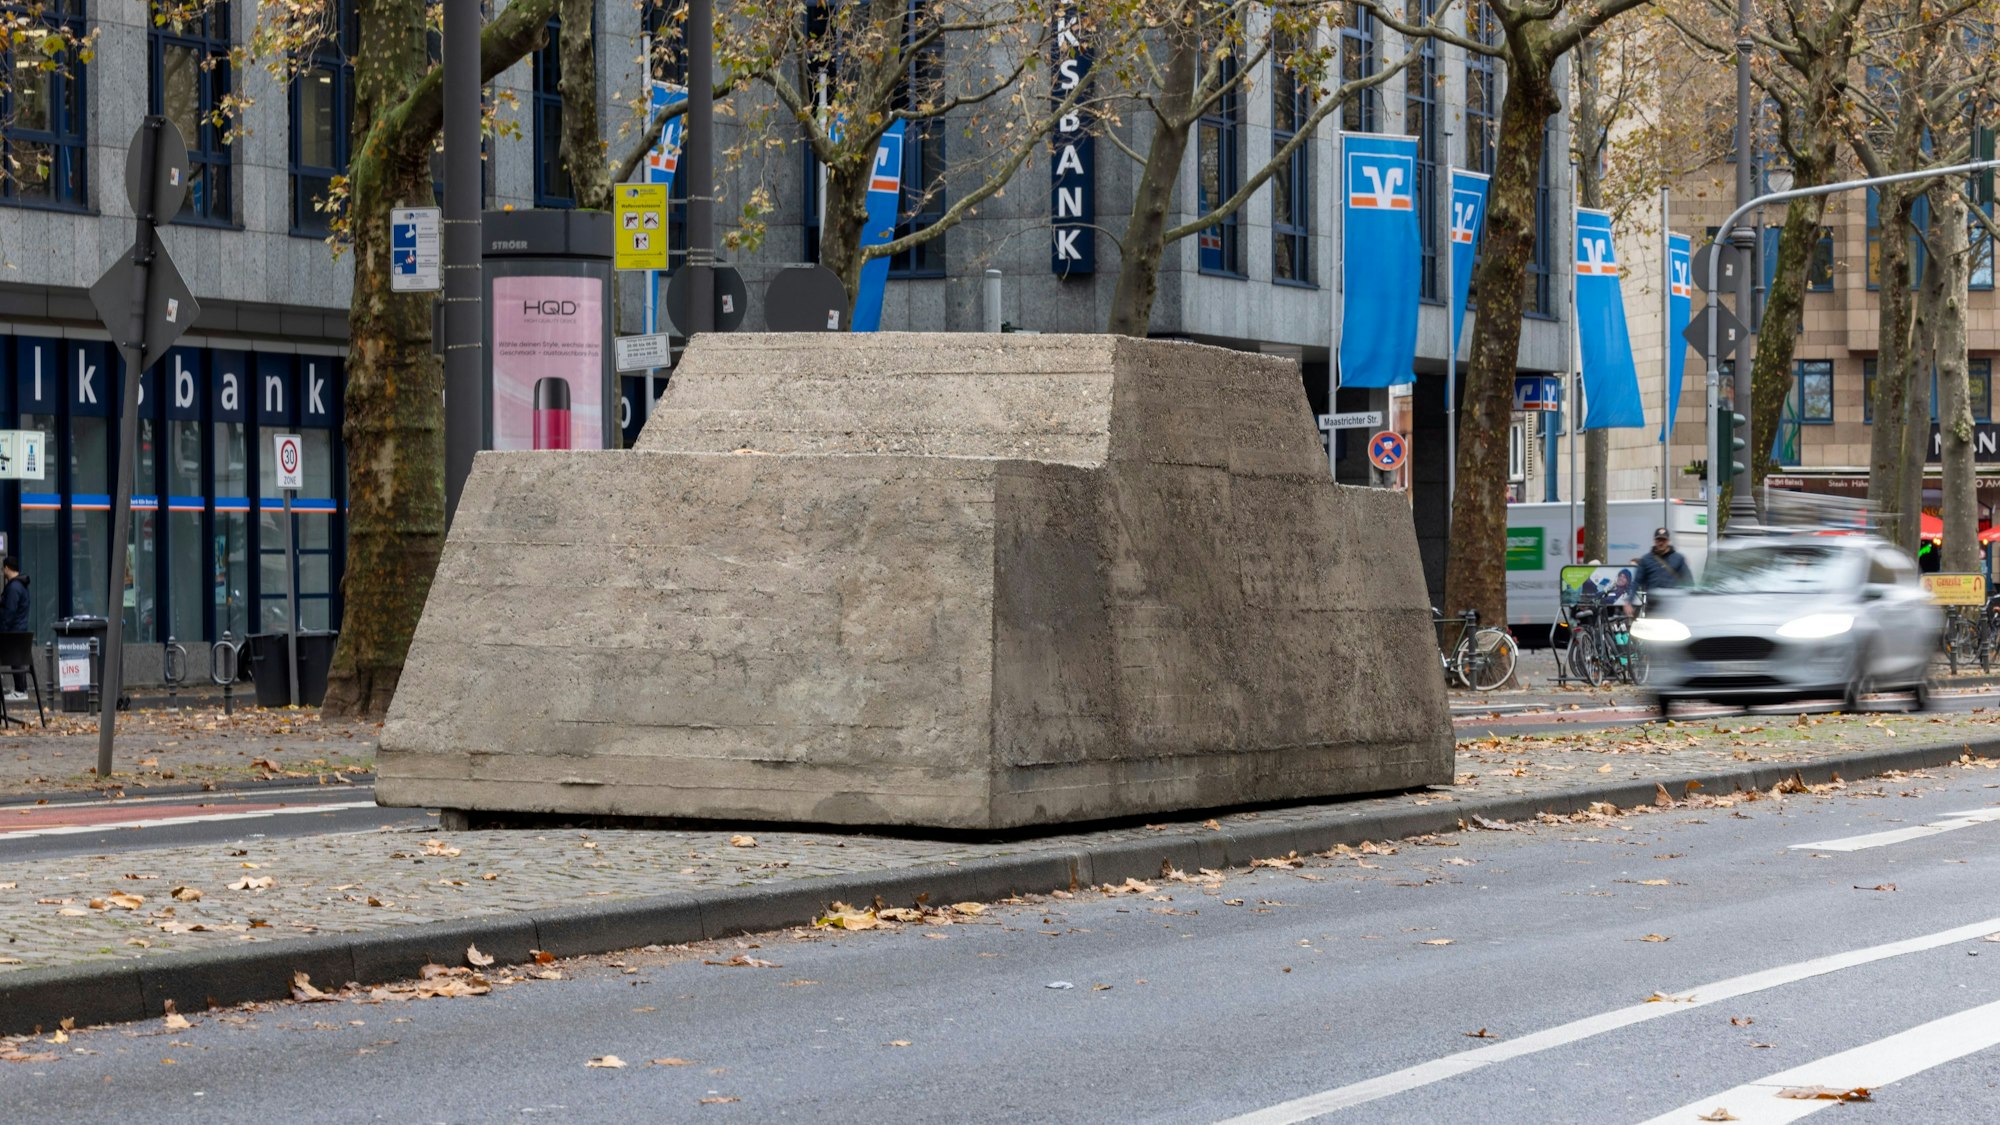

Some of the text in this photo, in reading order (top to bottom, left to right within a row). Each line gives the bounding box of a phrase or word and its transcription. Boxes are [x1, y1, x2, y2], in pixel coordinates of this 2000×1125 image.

[491, 240, 528, 250] STRÖER
[542, 341, 560, 349] Style,
[1324, 414, 1379, 427] Maastrichter Str.
[284, 449, 294, 464] 30
[284, 476, 296, 485] ZONE
[1828, 479, 1848, 488] Steaks
